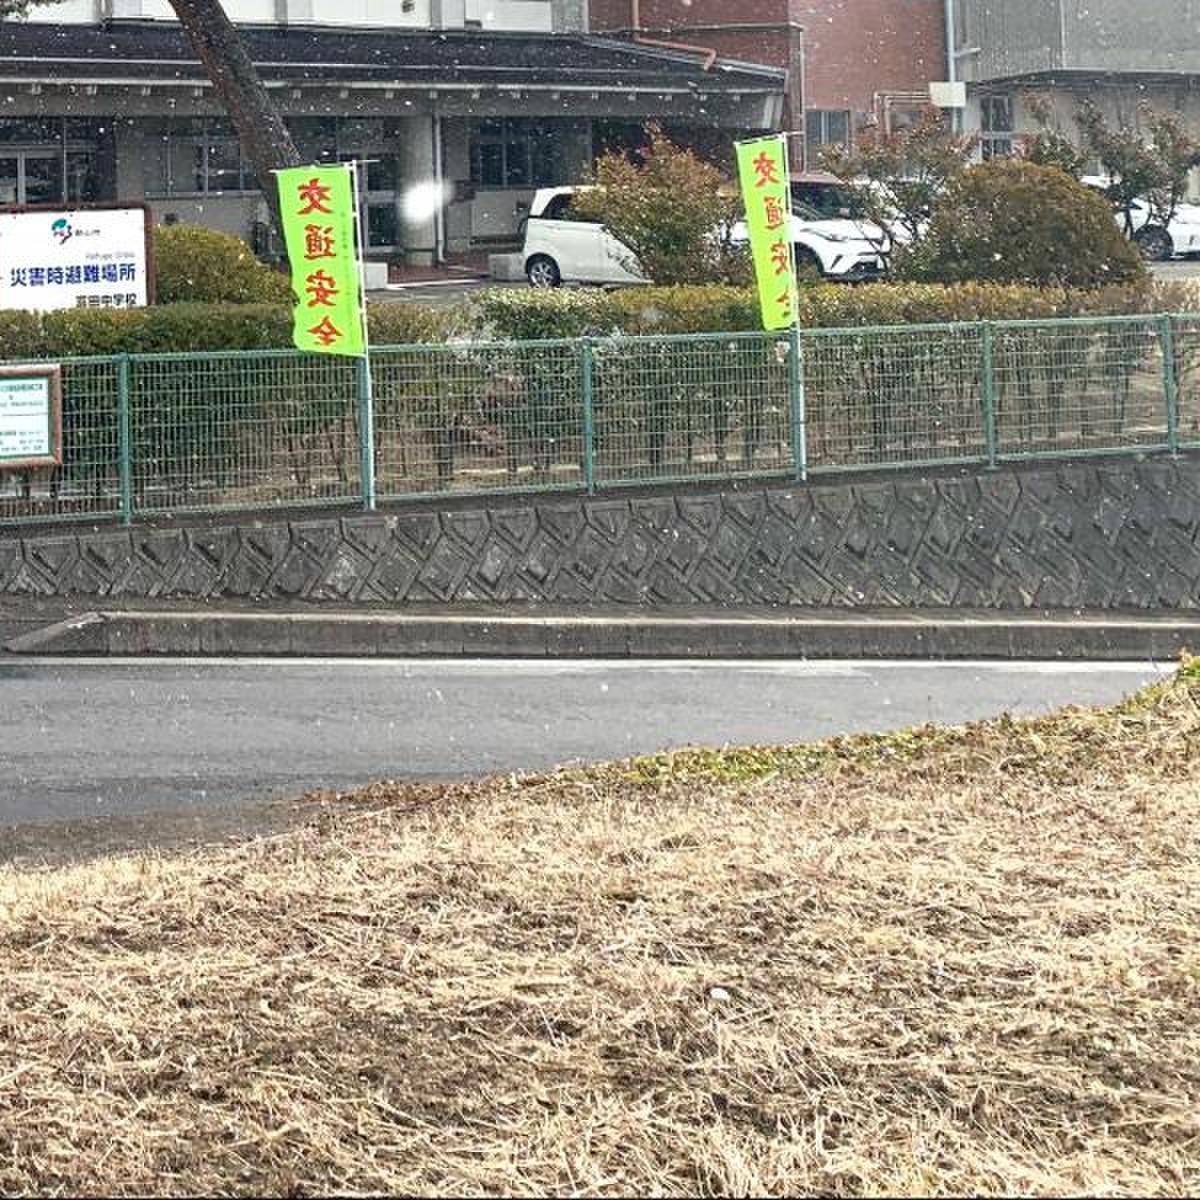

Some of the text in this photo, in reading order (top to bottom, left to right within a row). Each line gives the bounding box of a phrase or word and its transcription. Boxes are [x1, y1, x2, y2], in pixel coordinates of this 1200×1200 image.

[10, 262, 136, 287] 災害時避難場所
